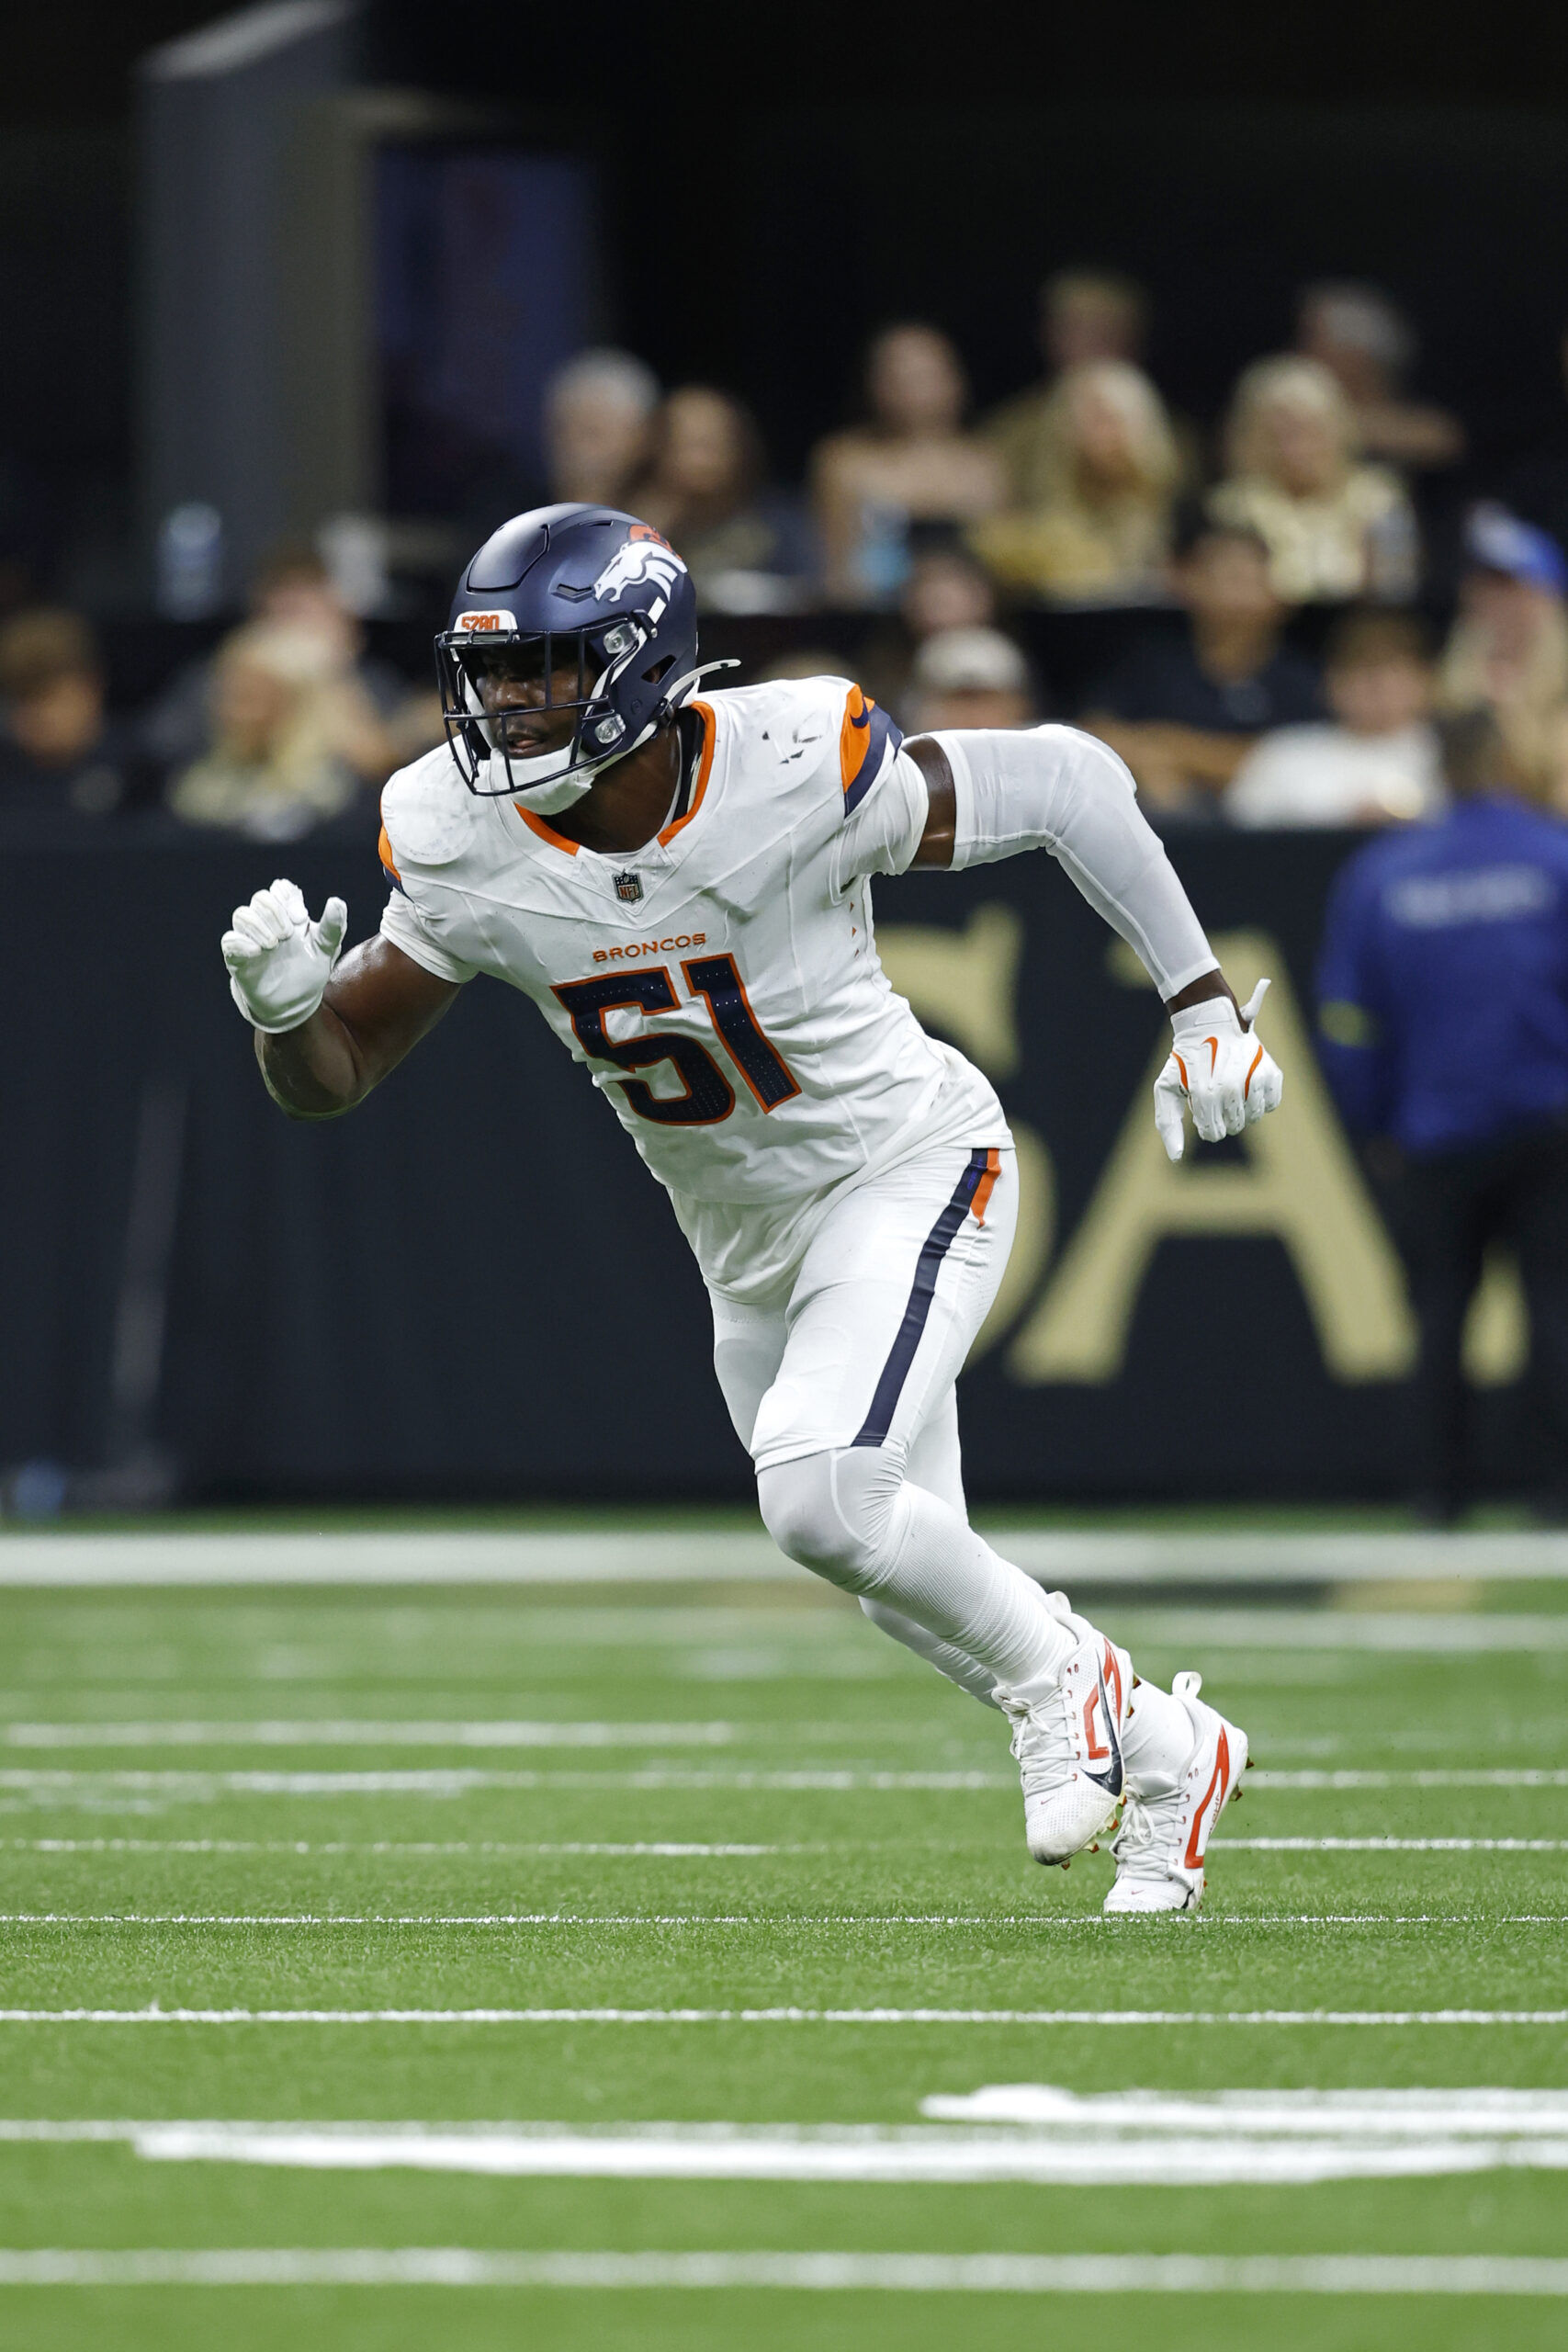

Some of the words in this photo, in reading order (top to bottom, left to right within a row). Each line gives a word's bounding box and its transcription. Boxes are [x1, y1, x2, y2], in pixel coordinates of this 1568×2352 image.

[461, 615, 500, 631] 5280
[617, 885, 640, 899] NFL
[592, 933, 706, 963] BRONCOS
[549, 953, 802, 1126] 51
